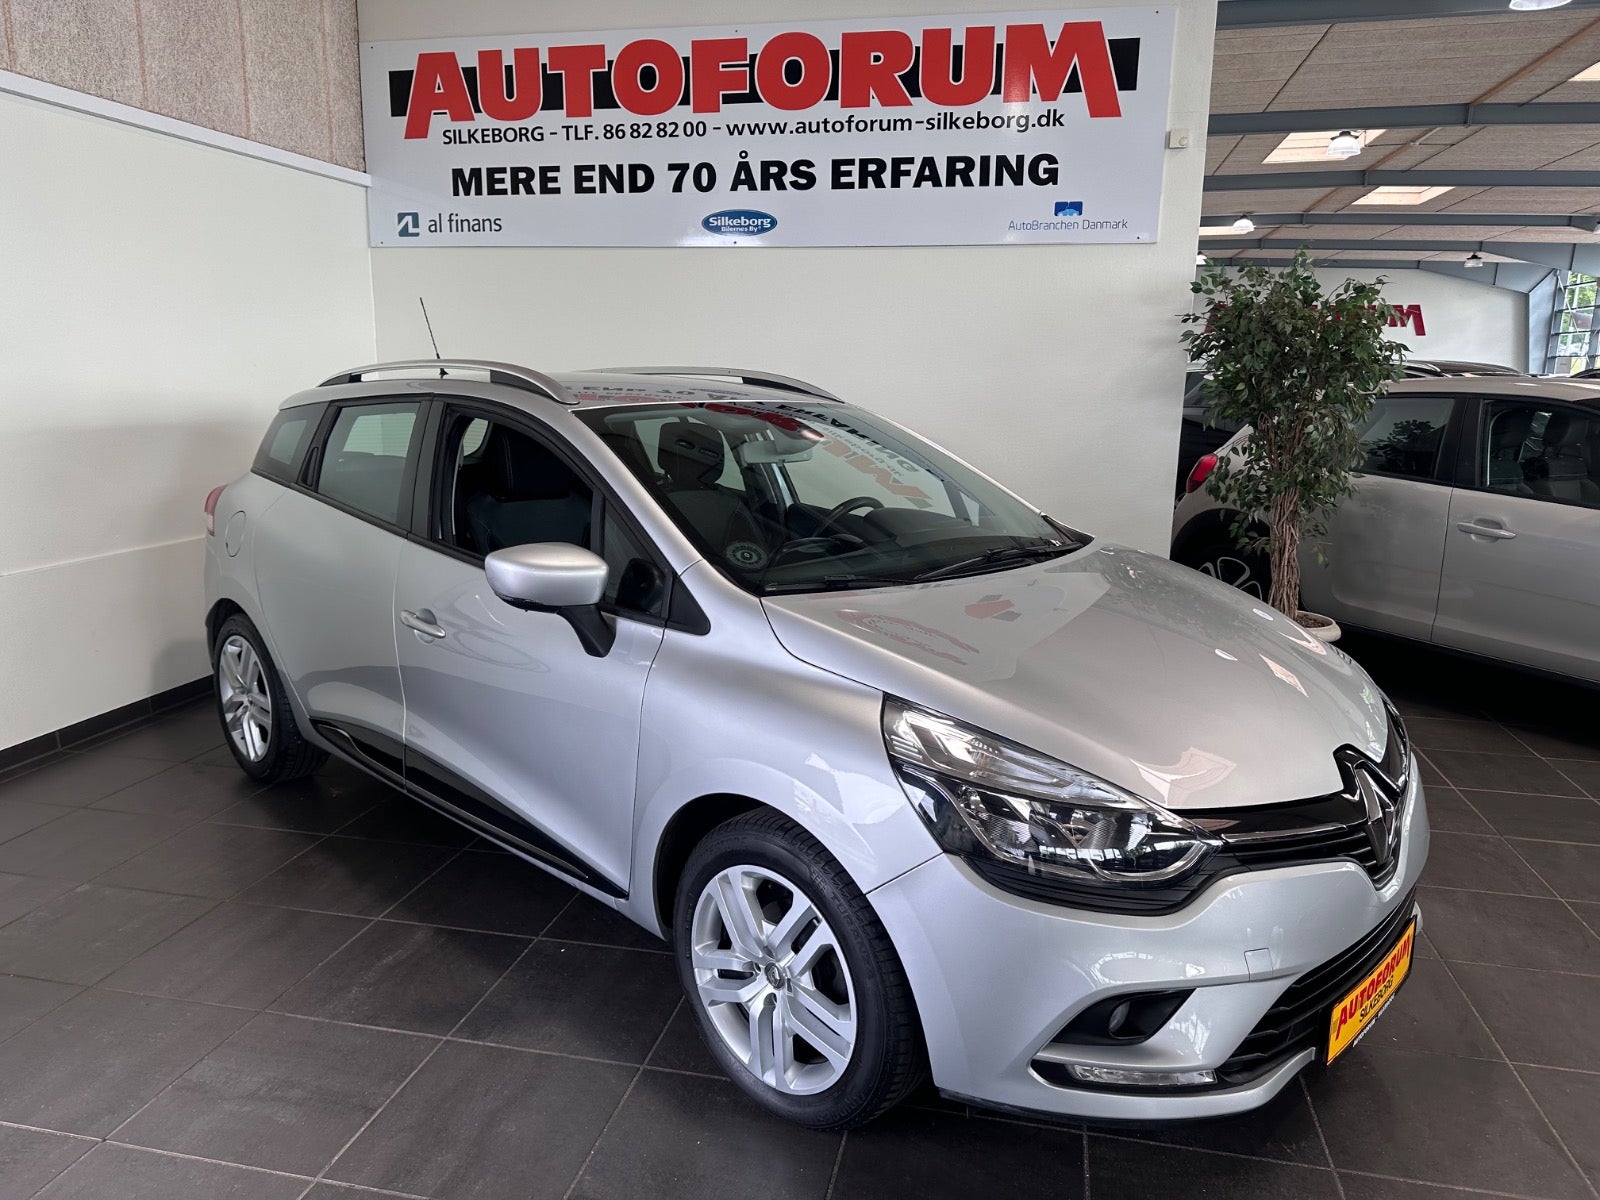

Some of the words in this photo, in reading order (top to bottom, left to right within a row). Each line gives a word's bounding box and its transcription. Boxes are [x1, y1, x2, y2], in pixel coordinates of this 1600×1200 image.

[404, 20, 1122, 140] AUTOFORUM
[442, 125, 545, 145] SILKEBORG
[561, 124, 599, 141] TLF.
[725, 108, 1065, 137] www.autoforum-silkeborg.dk
[451, 165, 562, 197] MERE
[573, 163, 655, 195] END
[667, 161, 717, 193] 70
[729, 149, 817, 192] ÅRS
[830, 153, 1059, 190] ERFARING
[428, 212, 443, 233] al
[447, 212, 503, 233] finans
[708, 215, 772, 229] Silkeborg
[1008, 219, 1079, 231] AutoBranchen
[1082, 218, 1128, 230] Danmark
[1335, 933, 1411, 1041] AUTOFORUM
[1359, 974, 1394, 1023] SILKEBORG
